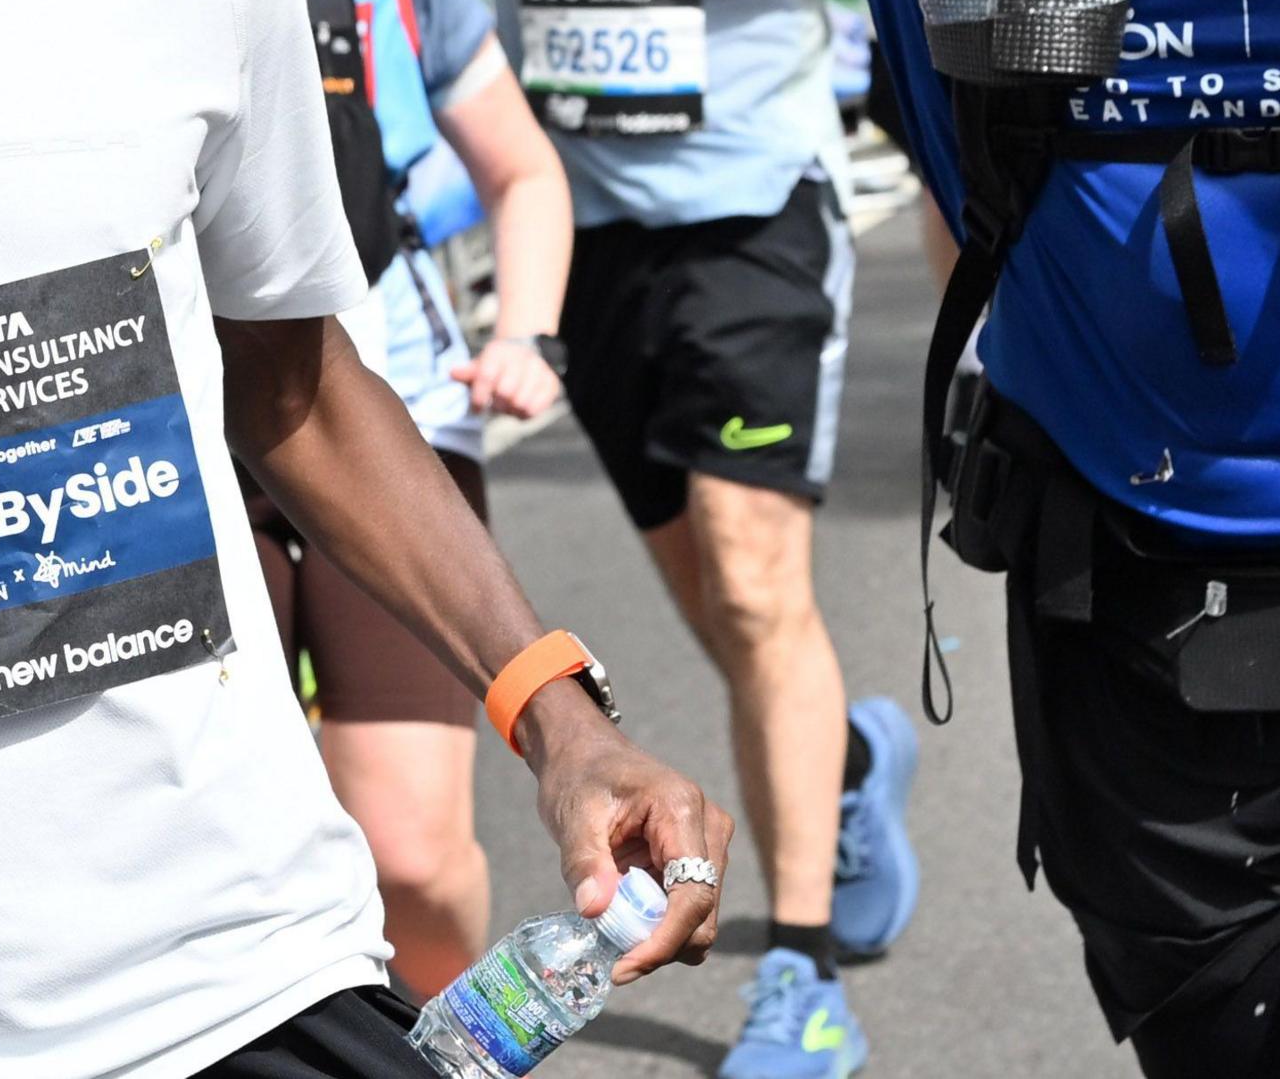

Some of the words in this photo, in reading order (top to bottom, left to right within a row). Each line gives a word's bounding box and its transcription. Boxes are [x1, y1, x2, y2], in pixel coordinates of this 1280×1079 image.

[546, 28, 670, 74] 62526
[1167, 72, 1224, 98] TO
[62, 550, 116, 578] mind
[63, 618, 195, 673] balance
